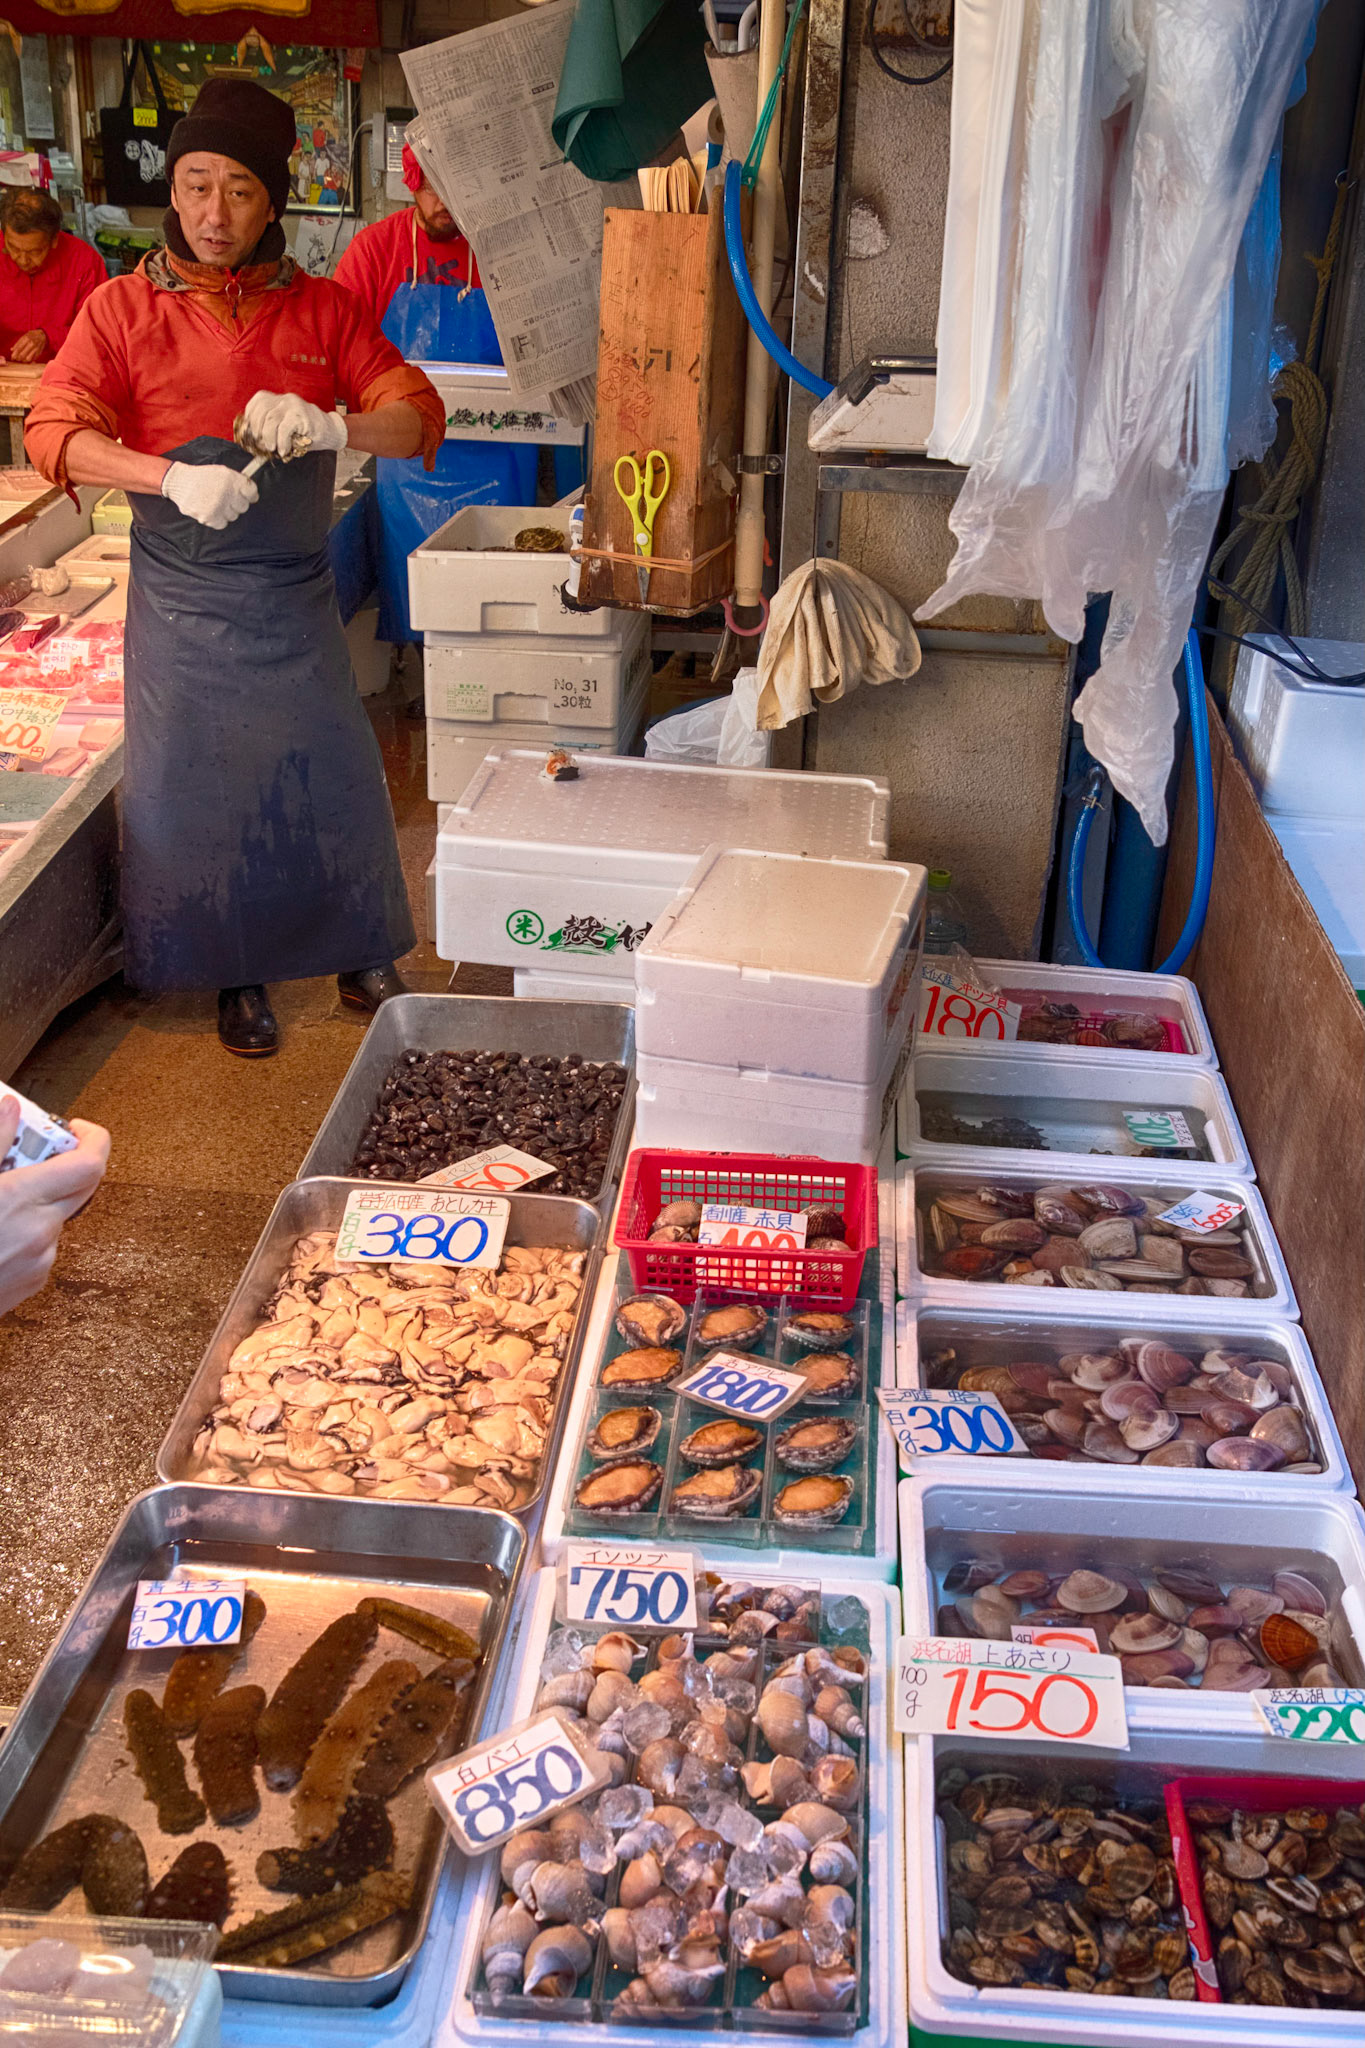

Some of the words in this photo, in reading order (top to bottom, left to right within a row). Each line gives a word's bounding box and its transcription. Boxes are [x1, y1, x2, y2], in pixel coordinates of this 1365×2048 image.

[581, 680, 598, 693] 31
[513, 914, 537, 939] 米
[923, 985, 1005, 1040] 180
[1125, 1114, 1179, 1147] 300
[431, 1195, 498, 1215] おとしカキ
[754, 1210, 796, 1233] 赤貝
[358, 1213, 489, 1263] 380
[684, 1365, 789, 1413] 1800
[908, 1404, 1015, 1453] 300
[586, 1549, 669, 1566] イソツブ
[570, 1566, 689, 1625] 750
[143, 1596, 242, 1646] 300
[912, 1639, 972, 1664] 浜名湖
[977, 1643, 1071, 1672] 上あさり
[900, 1665, 928, 1686] 100
[905, 1689, 923, 1718] g
[943, 1667, 1099, 1739] 150
[1278, 1703, 1365, 1744] 220
[455, 1744, 584, 1843] 850
